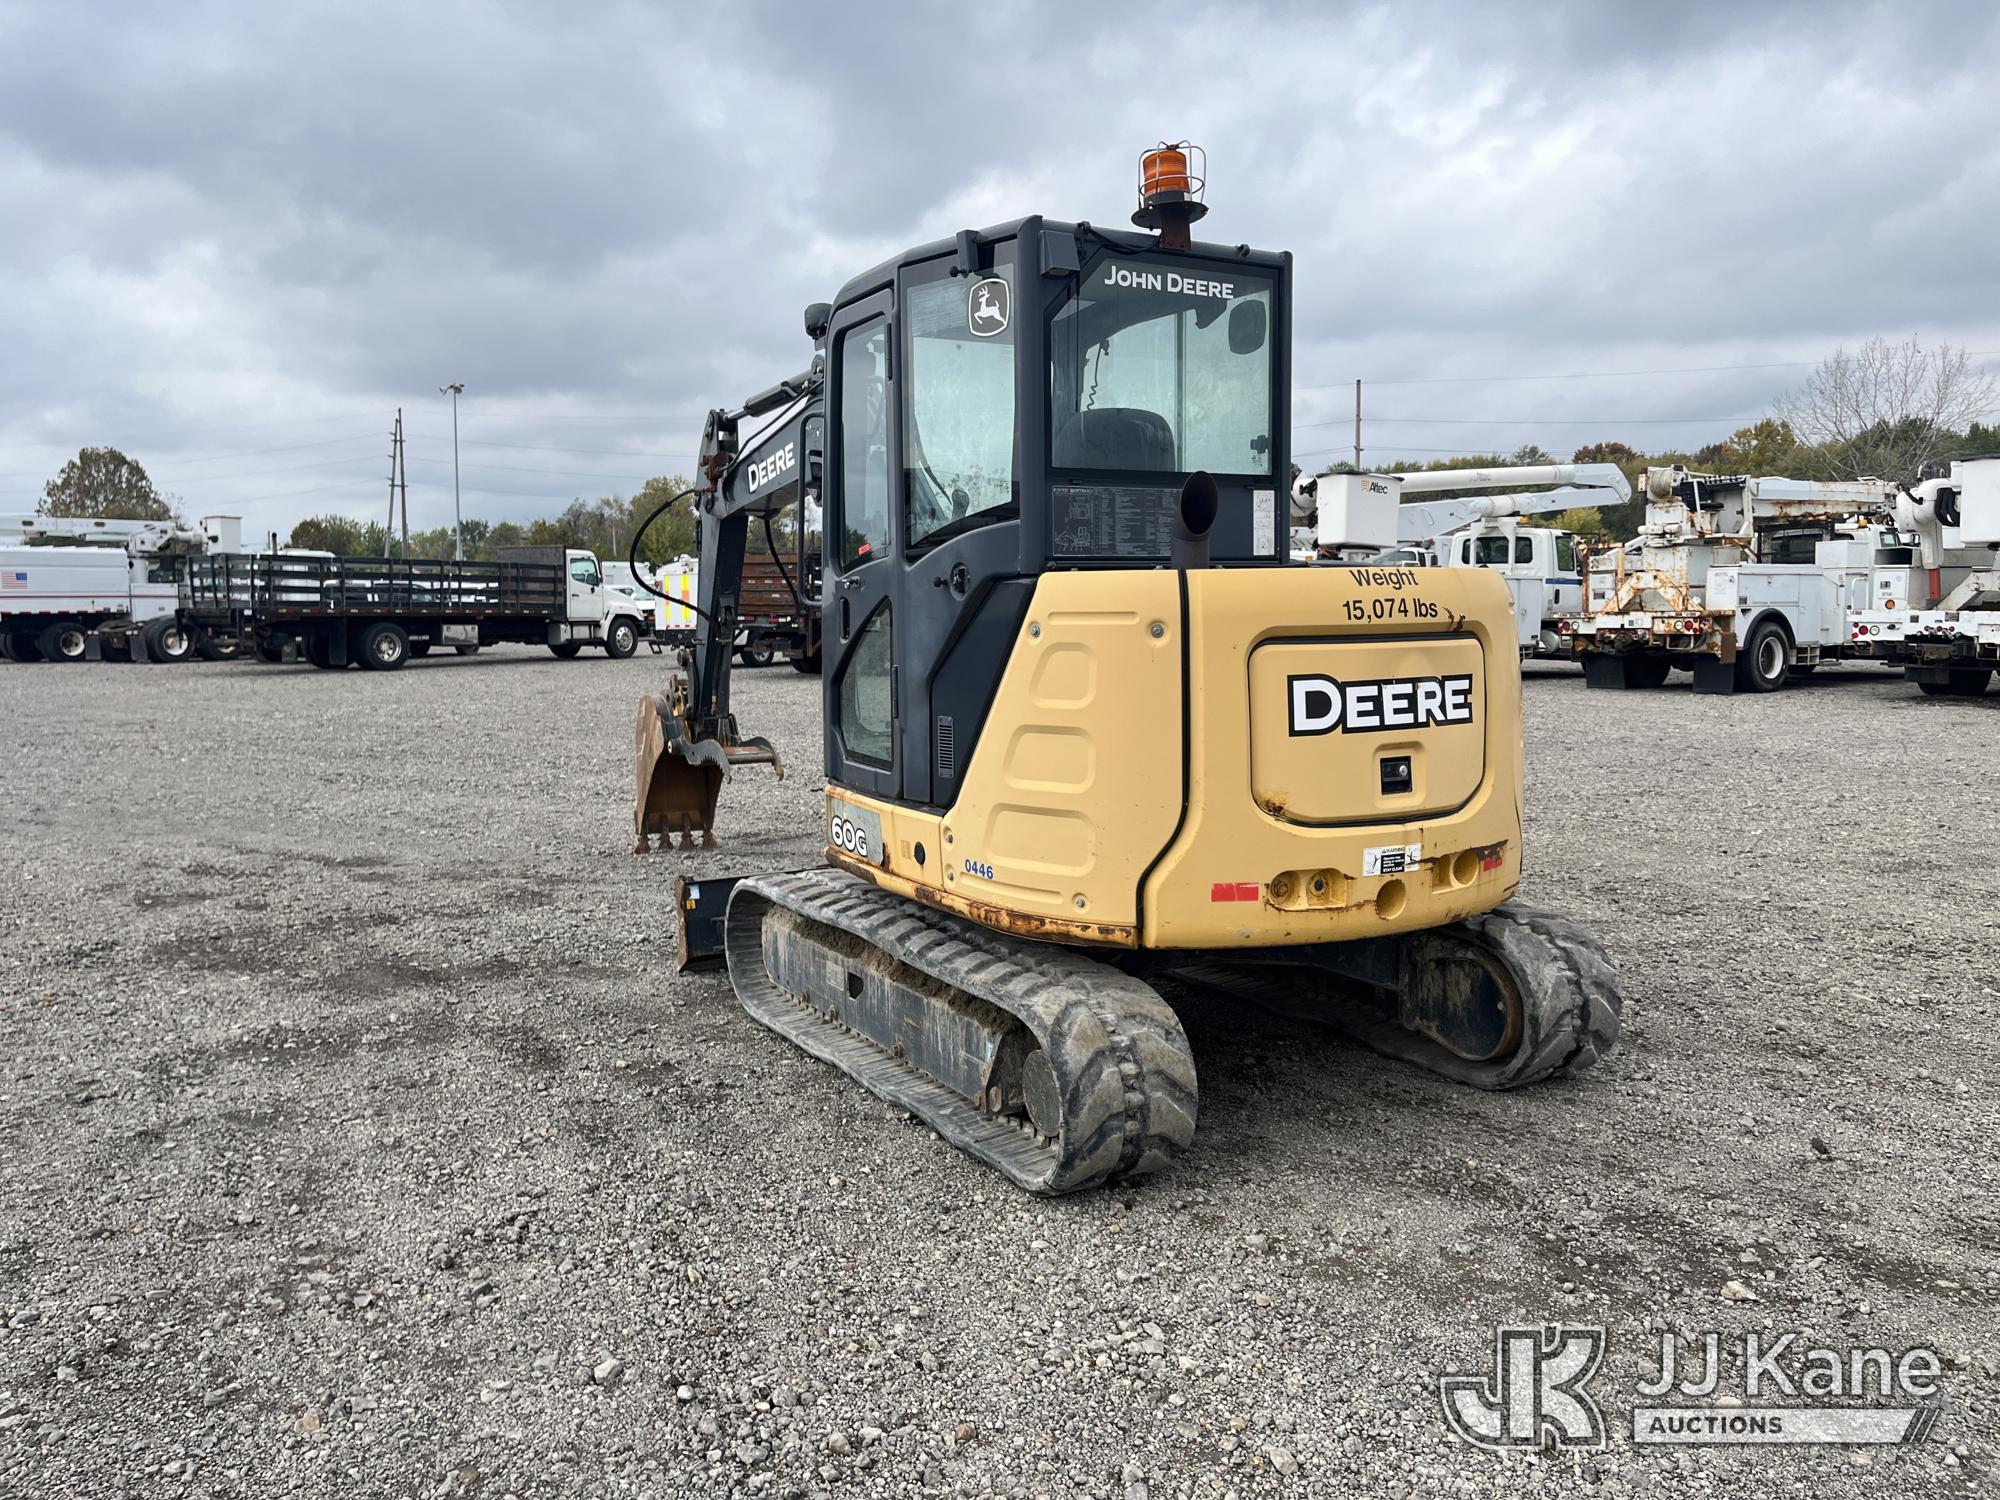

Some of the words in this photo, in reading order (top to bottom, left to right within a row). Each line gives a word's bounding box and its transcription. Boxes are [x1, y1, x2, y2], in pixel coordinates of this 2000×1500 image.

[1104, 265, 1162, 291] JOHN
[1167, 272, 1234, 299] DEERE
[747, 441, 796, 493] DEERE
[1369, 481, 1388, 495] Altec
[1349, 569, 1419, 590] Weight
[1342, 598, 1409, 624] 15,074
[1413, 598, 1438, 618] lbs
[1291, 677, 1471, 733] DEERE
[831, 815, 868, 857] 60G
[964, 859, 994, 880] 0446
